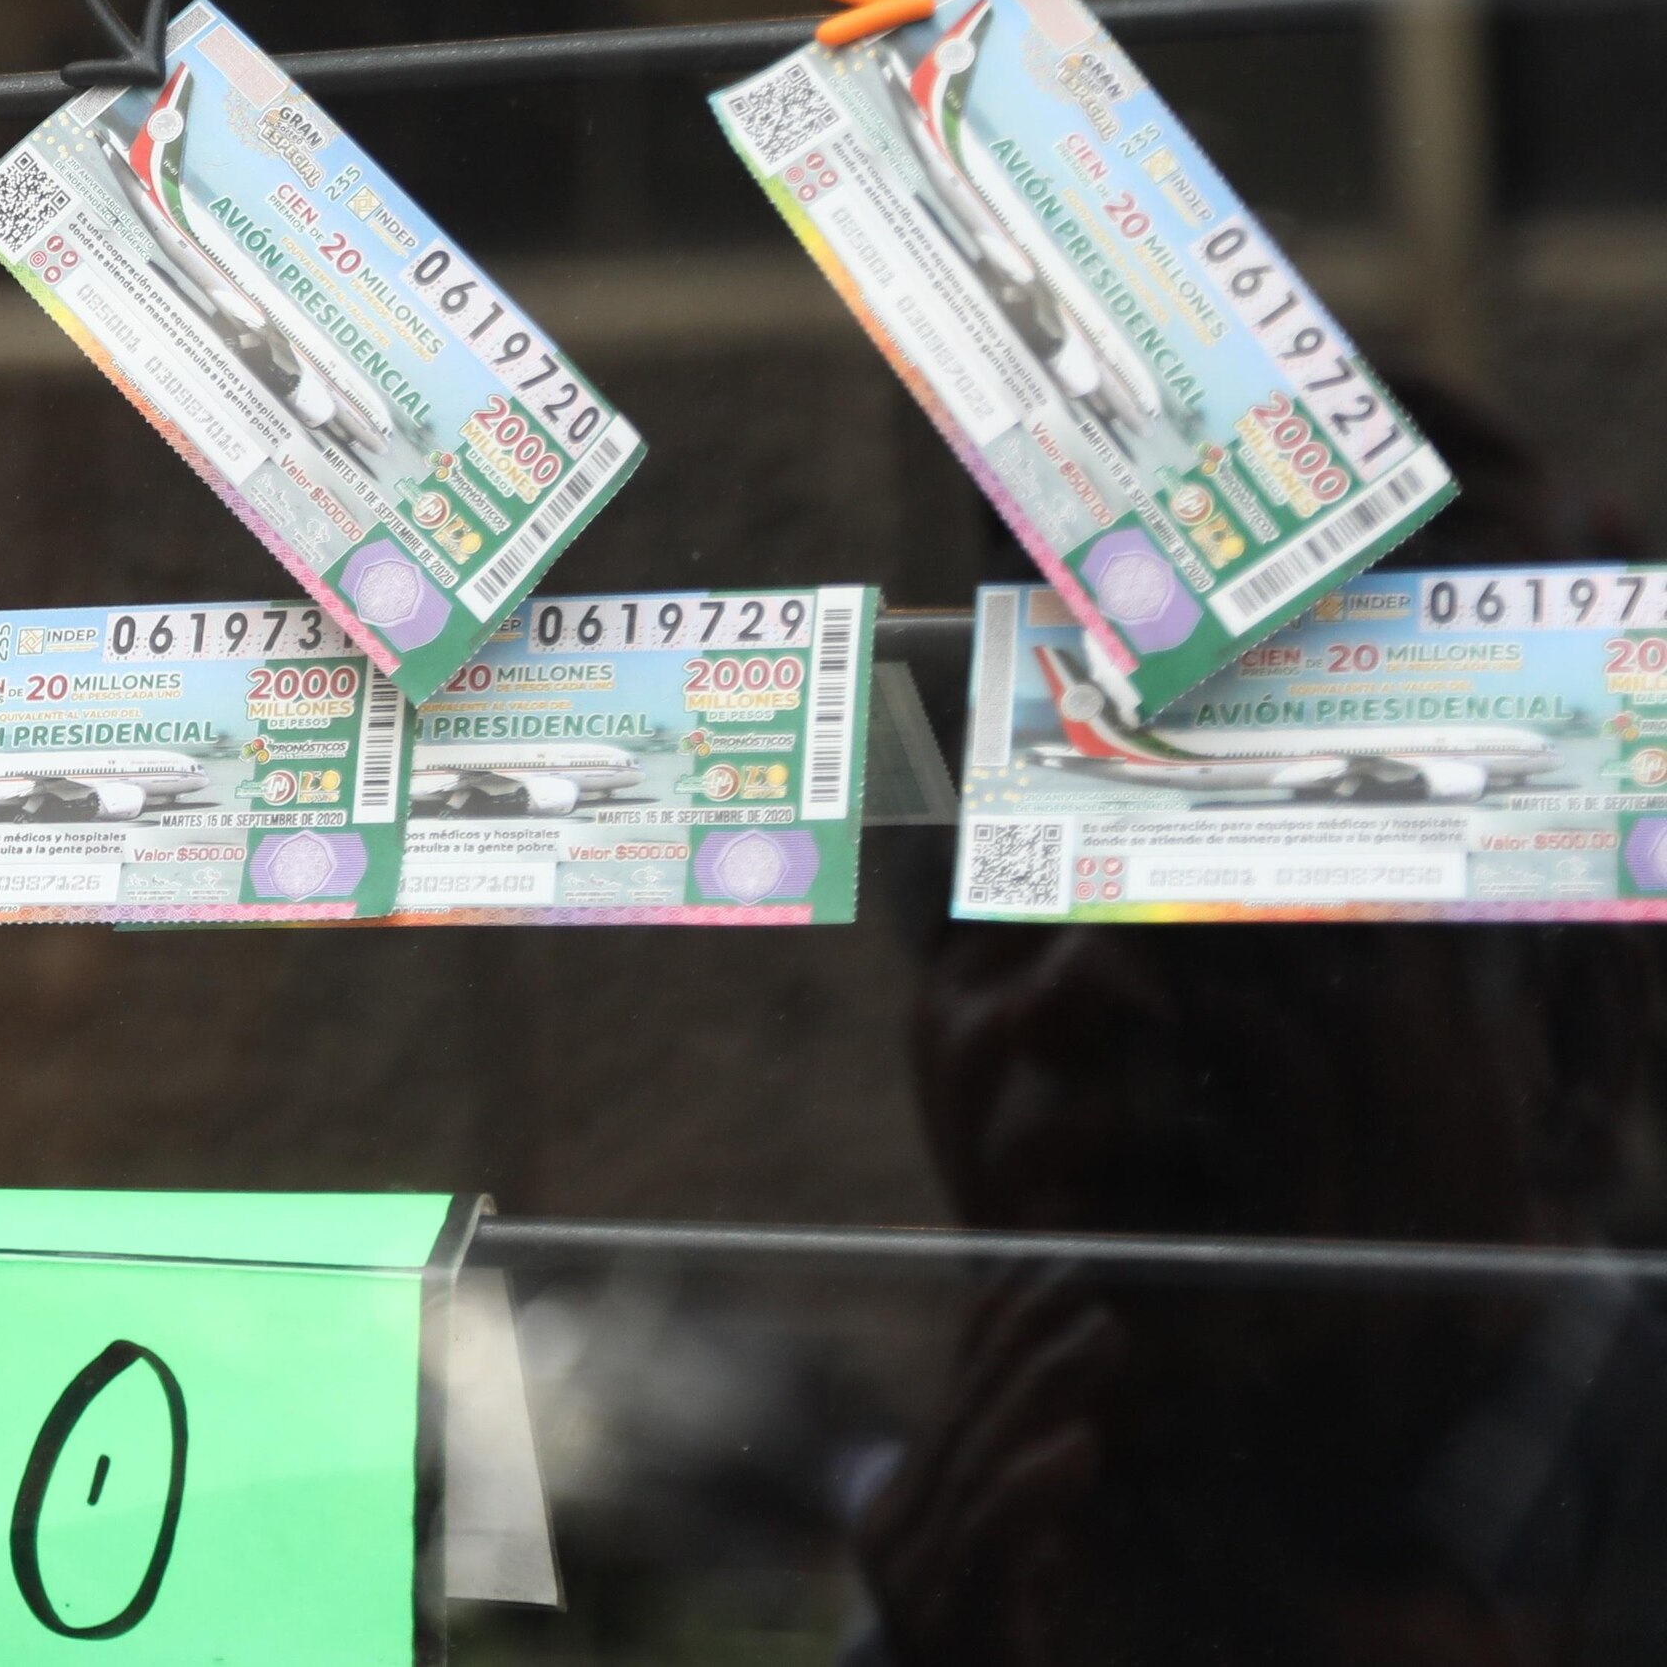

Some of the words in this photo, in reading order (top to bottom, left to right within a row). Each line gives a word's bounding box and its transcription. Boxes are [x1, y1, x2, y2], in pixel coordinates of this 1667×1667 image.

[1103, 192, 1150, 238] 20
[275, 182, 320, 227] CIEN
[319, 232, 362, 274] 20
[356, 266, 443, 354] MILLONES
[989, 138, 1064, 221] AVIÓN
[1054, 220, 1204, 414] PRESIDENCIAL
[209, 197, 284, 268] AVIÓN
[277, 264, 430, 428] PRESIDENCIAL
[413, 249, 600, 444] 0619720
[1205, 224, 1411, 470] 0619721
[473, 395, 565, 488] 2000
[1252, 392, 1347, 502] 2000
[459, 421, 543, 506] MILLONES
[46, 628, 96, 642] INDEP
[537, 596, 809, 645] 0619729
[686, 657, 802, 692] 2000
[1327, 643, 1380, 674] 20
[26, 673, 69, 702] 20
[72, 672, 181, 692] MILLONES
[249, 666, 357, 700] 2000
[446, 664, 492, 693] 20
[496, 663, 613, 683] MILLONES
[249, 700, 353, 717] MILLONES
[687, 691, 799, 709] MILLONES
[1197, 694, 1306, 727] AVIÓN
[1316, 694, 1569, 722] PRESIDENCIAL
[13, 720, 216, 746] PRESIDENCIAL
[433, 712, 652, 739] PRESIDENCIAL
